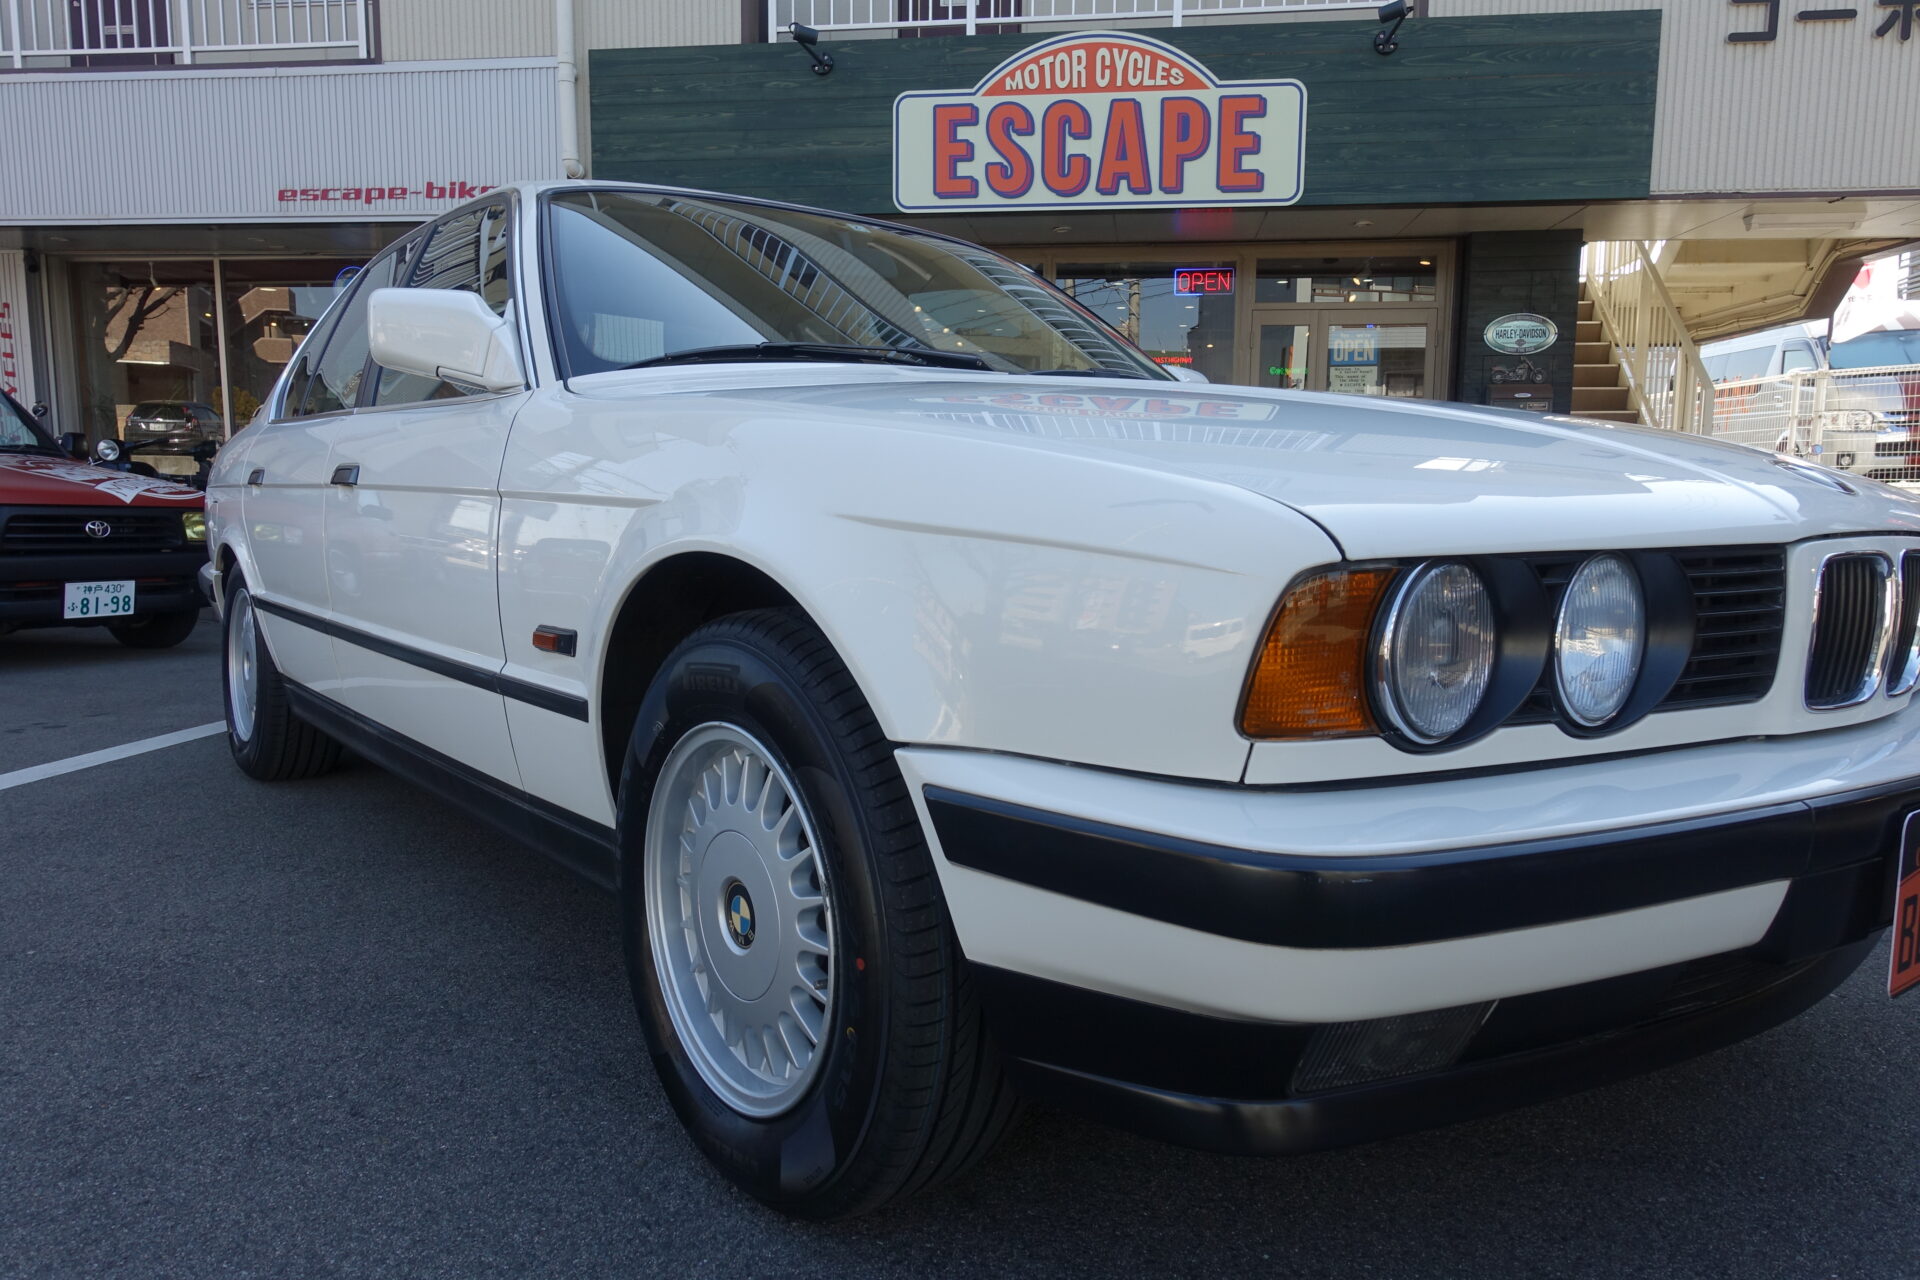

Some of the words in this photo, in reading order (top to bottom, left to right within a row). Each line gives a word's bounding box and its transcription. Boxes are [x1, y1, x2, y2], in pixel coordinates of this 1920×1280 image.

[1005, 49, 1087, 91] MOTOR
[1095, 47, 1185, 88] CYCLES
[932, 95, 1267, 198] ESCAPE
[1178, 272, 1231, 292] OPEN
[1495, 328, 1547, 339] HARLEY-DAVIDSON
[1333, 338, 1375, 361] OPEN
[83, 585, 103, 594] 神戸
[104, 584, 122, 594] 430
[80, 595, 131, 615] 81-98
